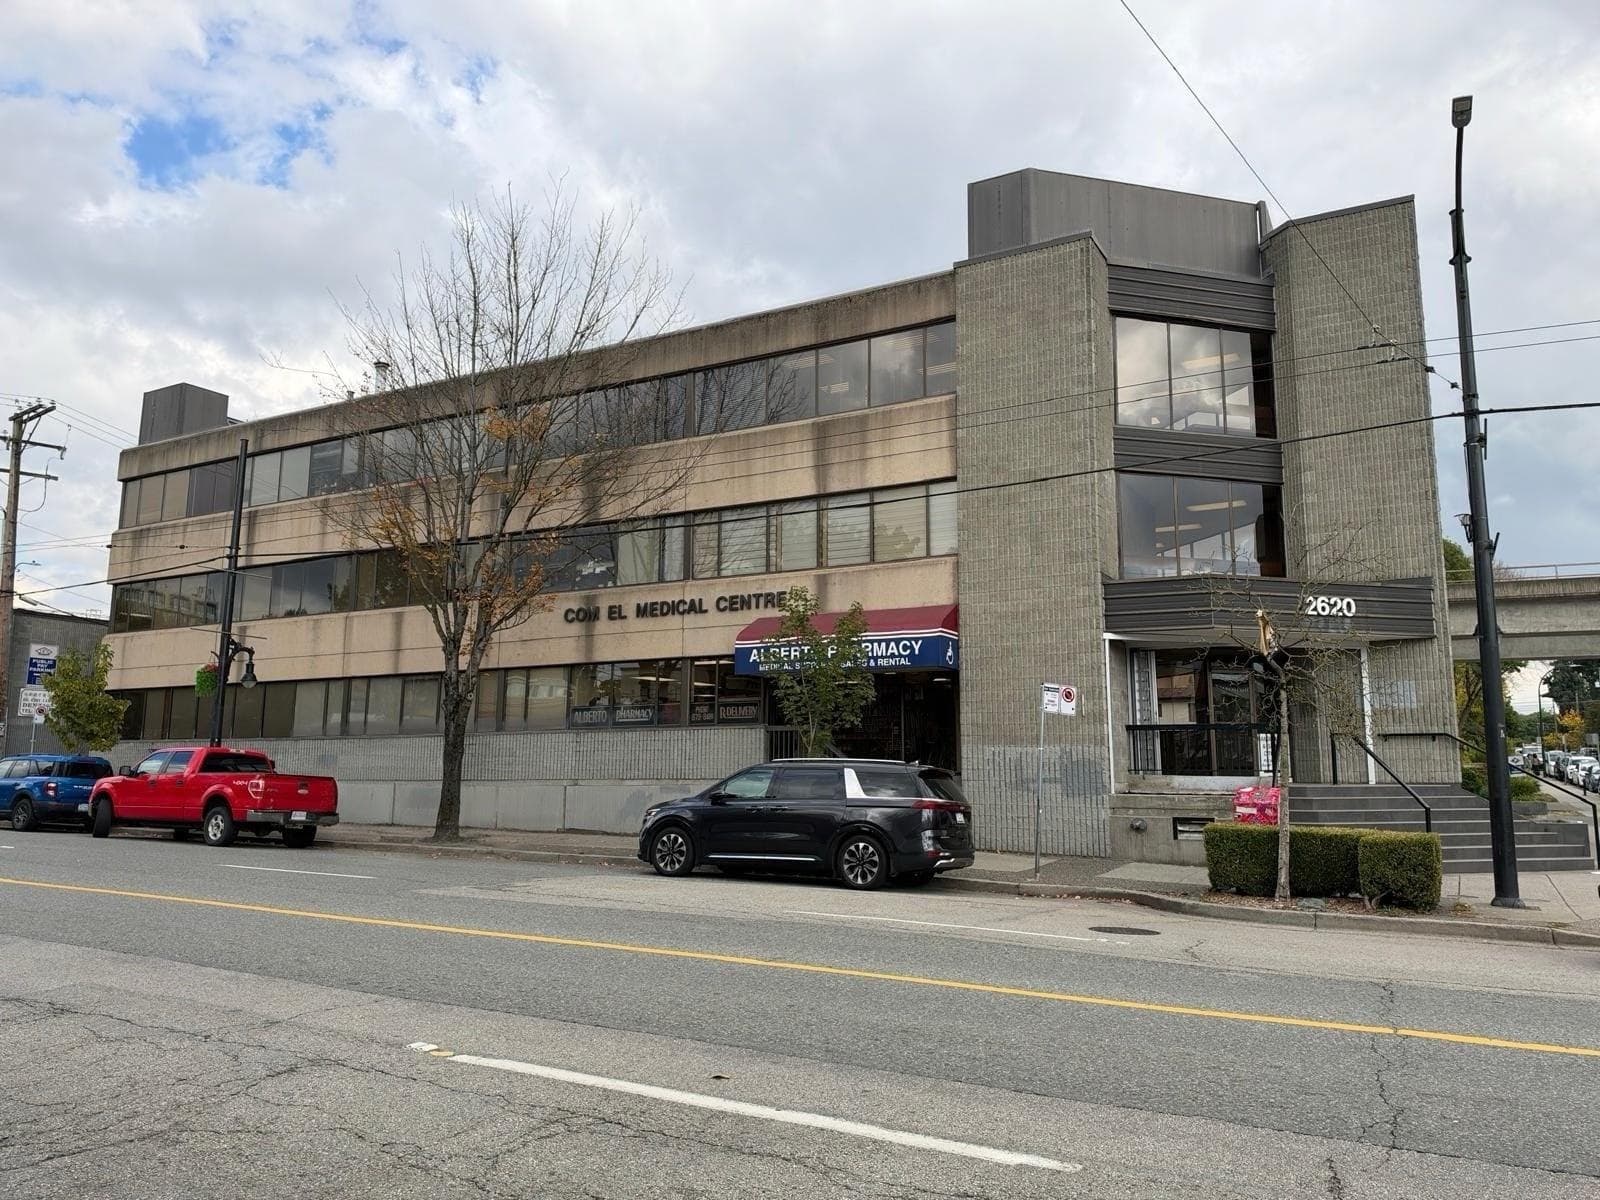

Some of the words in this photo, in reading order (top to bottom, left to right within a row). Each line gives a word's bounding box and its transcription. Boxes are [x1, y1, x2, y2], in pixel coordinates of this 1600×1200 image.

[563, 606, 600, 623] COM
[607, 604, 627, 620] EL
[635, 598, 708, 618] MEDICAL
[715, 591, 787, 612] CENTRE
[1305, 596, 1356, 617] 2620
[749, 646, 819, 662] ALBERT
[827, 640, 922, 659] PRMACY
[759, 661, 794, 671] MEDIAL
[869, 659, 875, 667] &
[877, 657, 911, 667] RENTAL
[574, 710, 607, 723] ALBERTO
